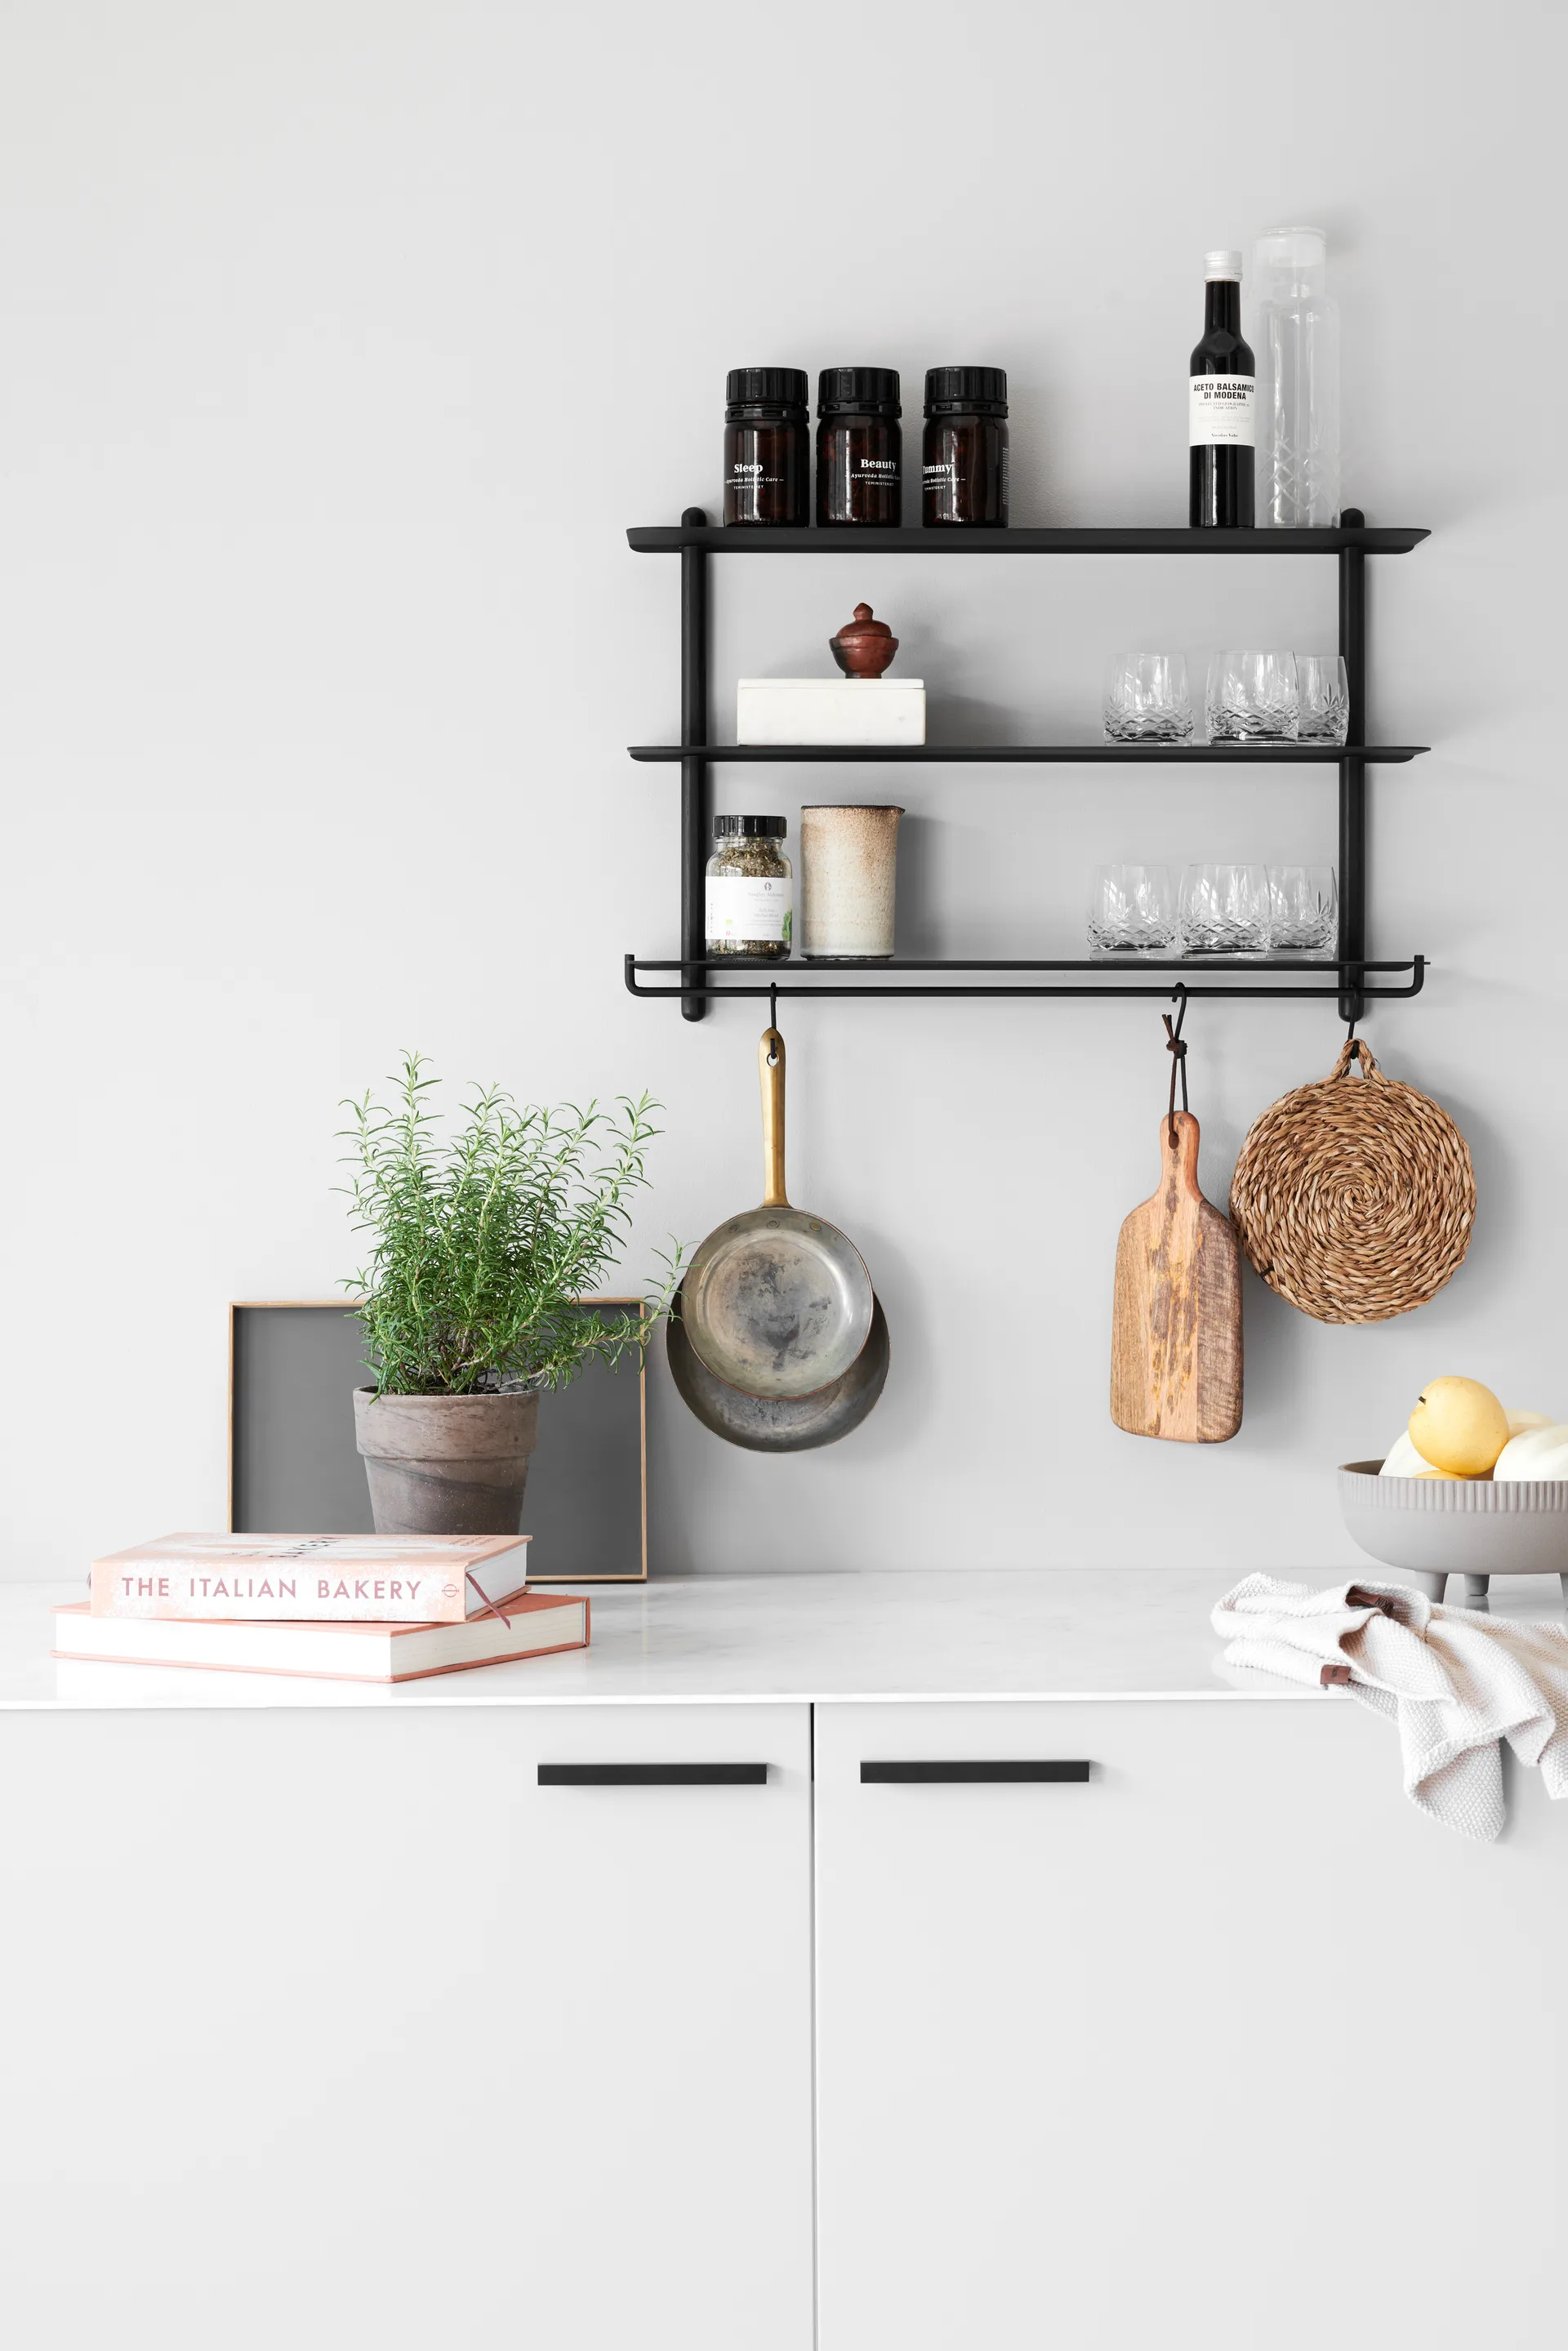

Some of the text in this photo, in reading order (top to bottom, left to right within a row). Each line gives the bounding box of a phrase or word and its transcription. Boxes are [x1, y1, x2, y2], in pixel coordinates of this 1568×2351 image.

[1194, 383, 1254, 393] ACETO BALSAMICO
[1214, 392, 1246, 400] MODENA
[734, 463, 764, 474] Sleep
[860, 459, 897, 472] Beauty
[122, 1577, 421, 1601] THE ITALIAN BAKERY
